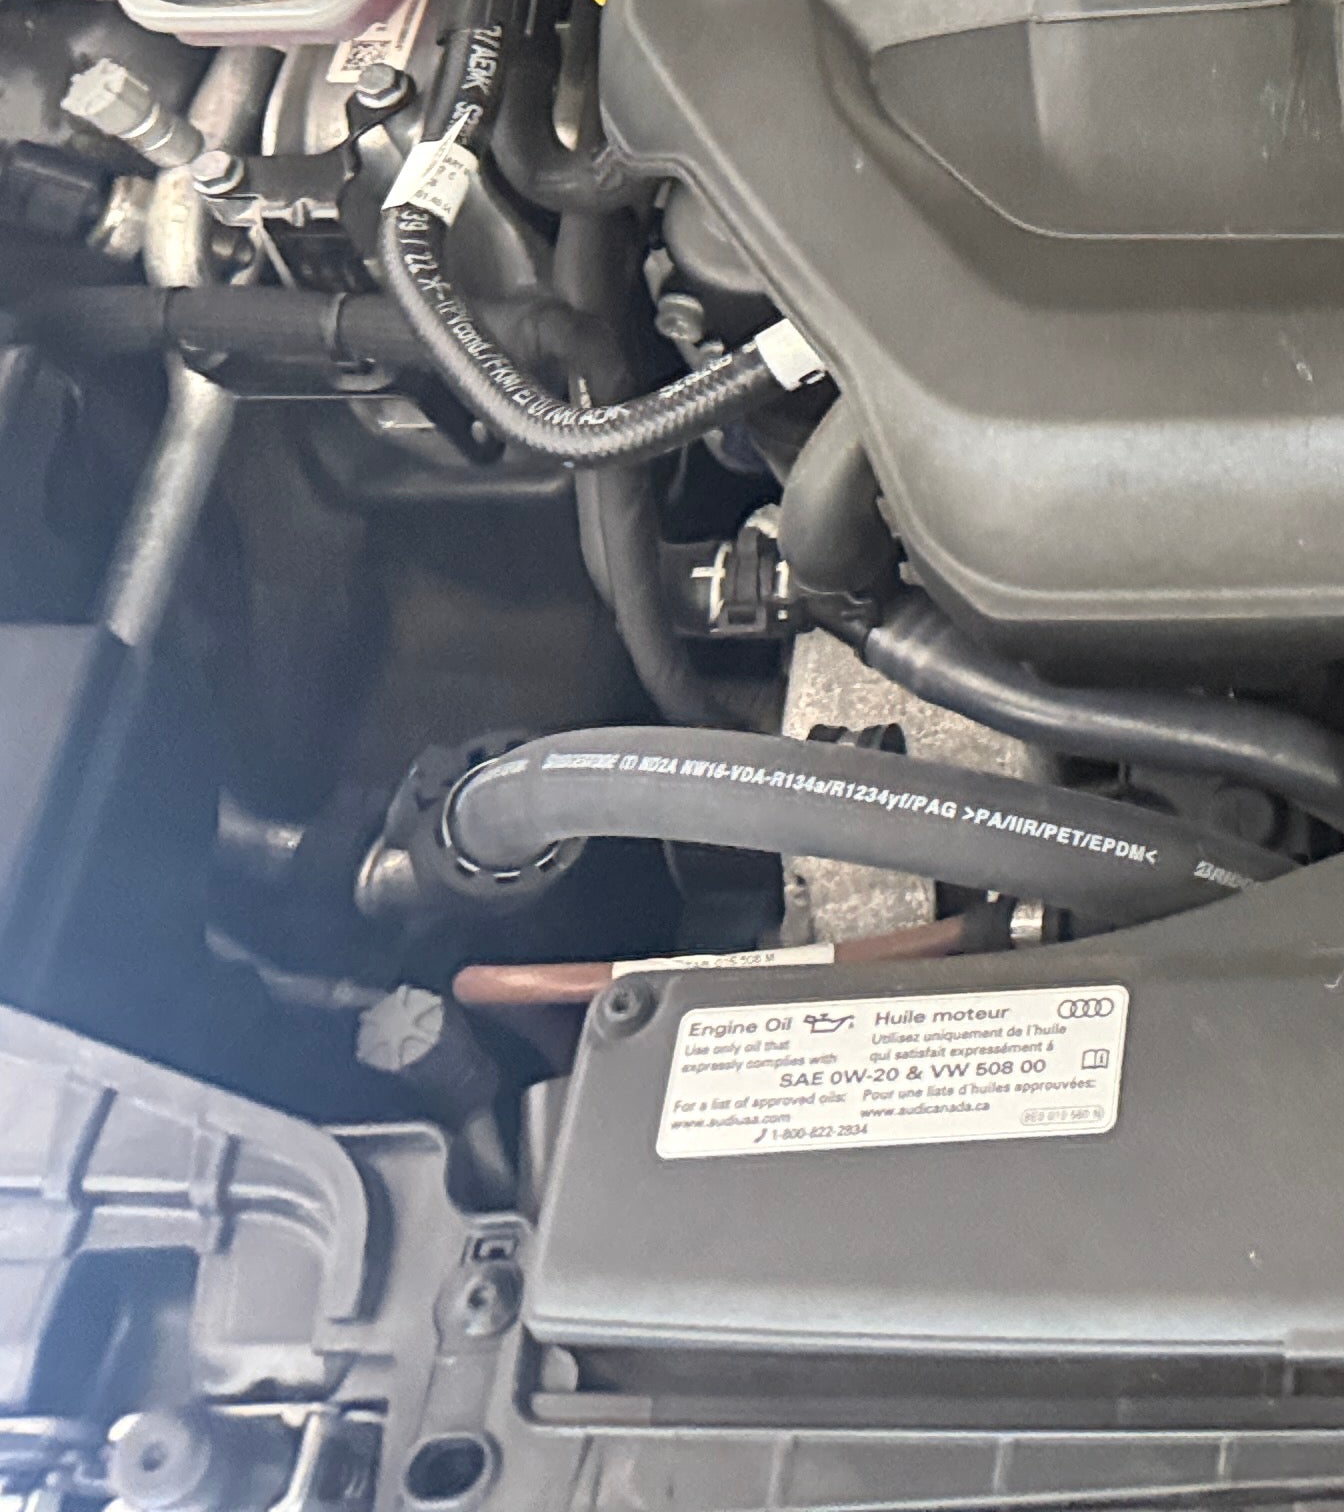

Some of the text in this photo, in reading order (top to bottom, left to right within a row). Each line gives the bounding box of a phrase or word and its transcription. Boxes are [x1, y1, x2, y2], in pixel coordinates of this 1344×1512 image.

[875, 1006, 1010, 1026] Huile moteur
[688, 1017, 792, 1039] Engine Oil
[923, 1027, 1004, 1043] uniquement
[1006, 1025, 1024, 1037] de
[869, 1049, 890, 1062] qui
[894, 1046, 946, 1060] satisfait
[779, 1058, 1047, 1088] SAE 0W-20 & VW 508 00
[862, 1088, 895, 1101] Pour
[898, 1087, 923, 1099] une
[673, 1100, 696, 1113] For
[735, 1096, 749, 1109] of
[860, 1101, 991, 1119] www.audicanada.ca
